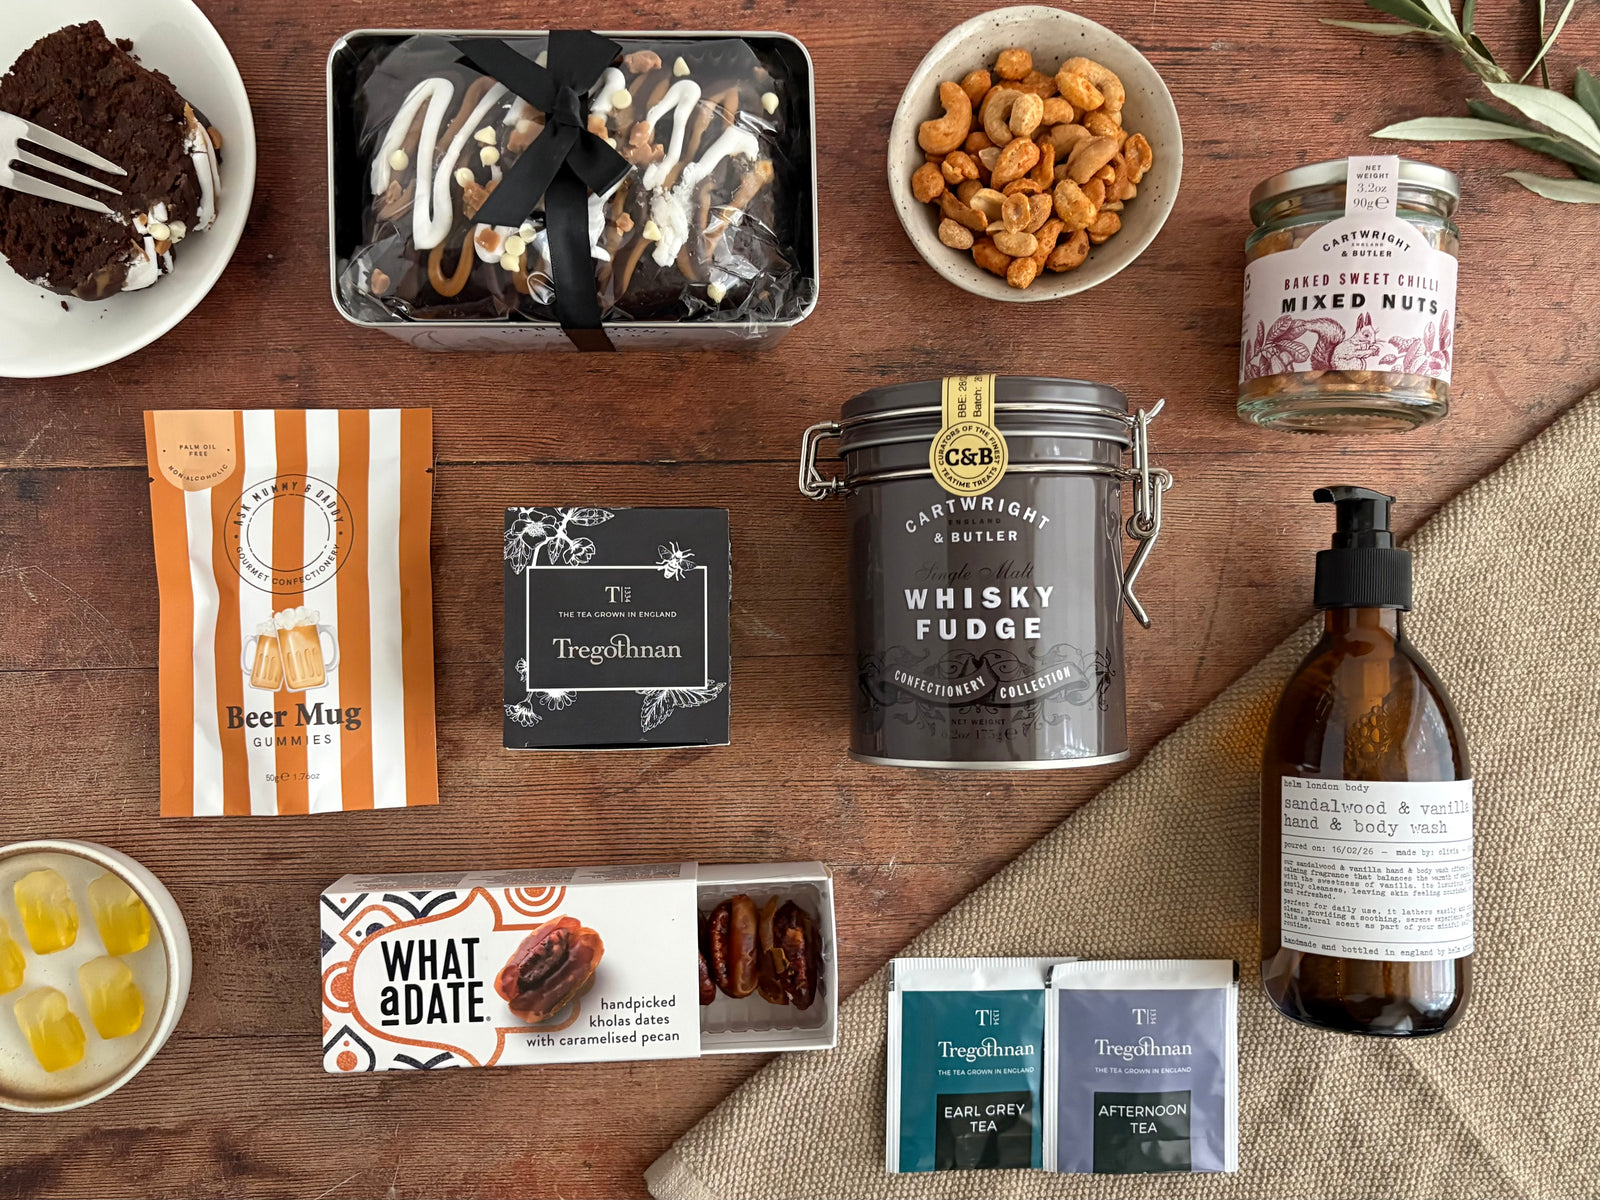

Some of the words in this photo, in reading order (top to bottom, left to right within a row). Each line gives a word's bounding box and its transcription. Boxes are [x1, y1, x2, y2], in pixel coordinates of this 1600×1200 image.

[1357, 183, 1387, 193] 3.2oz
[1322, 230, 1411, 252] CARTWRIGHT
[1284, 273, 1330, 291] BAKED
[1339, 273, 1390, 286] SWEET
[1398, 274, 1439, 292] CHILLI
[1282, 294, 1366, 314] MIXED
[1382, 294, 1438, 315] NUTS
[958, 394, 967, 418] BBE:
[973, 386, 982, 418] Batch:
[938, 428, 960, 466] CURATORS
[975, 426, 990, 438] THE
[990, 437, 1001, 465] FINEST
[945, 447, 994, 466] C&B
[941, 467, 971, 488] TEATIME
[972, 466, 998, 488] TREATS
[233, 503, 252, 526] ASK
[252, 482, 298, 502] MUMMY
[305, 484, 312, 493] &
[316, 489, 345, 523] DADDY
[905, 496, 1050, 534] CARTWRIGHT
[948, 518, 1001, 526] ENGLAND
[934, 532, 944, 544] &
[951, 530, 1018, 543] BUTLER
[236, 546, 270, 582] GOURMET
[272, 544, 340, 586] CONFECTIONERY
[914, 560, 972, 586] Single
[978, 559, 1035, 580] Malt
[604, 586, 621, 603] T
[904, 586, 1054, 610] WHISKY
[916, 617, 1041, 641] FUDGE
[552, 633, 683, 666] Tregothnan
[894, 669, 986, 698] CONFECTIONERY
[1000, 666, 1071, 700] COLLECTION
[225, 705, 288, 729] Beer
[295, 702, 362, 731] Mug
[253, 734, 332, 747] GUMMIES
[1284, 780, 1302, 788] helm
[1306, 780, 1339, 791] london
[1345, 784, 1370, 793] body
[1284, 798, 1387, 815] sandalwood
[1399, 801, 1410, 815] &
[1284, 813, 1320, 829] hand
[1330, 817, 1342, 831] &
[1353, 819, 1399, 837] body
[1410, 820, 1448, 834] wash
[1284, 841, 1308, 850] poured
[1332, 845, 1374, 856] 16/02/26
[1396, 849, 1417, 857] made
[1421, 849, 1434, 858] by:
[1296, 861, 1336, 871] sandalwood
[1416, 867, 1432, 875] body
[1311, 869, 1350, 878] fragrance
[1284, 873, 1298, 881] with
[1317, 879, 1360, 887] sweetness
[1284, 880, 1304, 889] gently
[1352, 888, 1386, 897] leaving
[1412, 890, 1441, 898] feeling
[1296, 889, 1336, 900] refreshed.
[1284, 899, 1310, 908] perfect
[1314, 902, 1328, 910] for
[1332, 905, 1357, 914] daily
[1284, 912, 1298, 920] this
[1301, 915, 1331, 925] natural
[1307, 909, 1347, 921] providing
[1360, 915, 1401, 923] soothing,
[1284, 920, 1312, 930] routine.
[1284, 936, 1317, 948] handmade
[1342, 945, 1379, 955] bottled
[1400, 949, 1433, 957] england
[381, 937, 480, 982] WHAT
[601, 994, 676, 1014] handpicked
[590, 1014, 631, 1028] kholas
[635, 1013, 670, 1026] dates
[975, 1009, 990, 1026] T
[1132, 1008, 1147, 1025] T
[526, 1033, 555, 1047] with
[559, 1030, 637, 1046] caramelised
[641, 1032, 680, 1047] pecan
[938, 1037, 1035, 1062] Tregothnan
[1094, 1036, 1192, 1061] Tregothnan
[1003, 1066, 1035, 1074] ENGLAND
[1161, 1066, 1192, 1074] ENGLAND
[945, 1106, 981, 1118] EARL
[985, 1103, 1025, 1117] GREY
[1098, 1103, 1187, 1118] AFTERNOON
[970, 1120, 998, 1133] TEA
[1130, 1122, 1158, 1134] TEA
